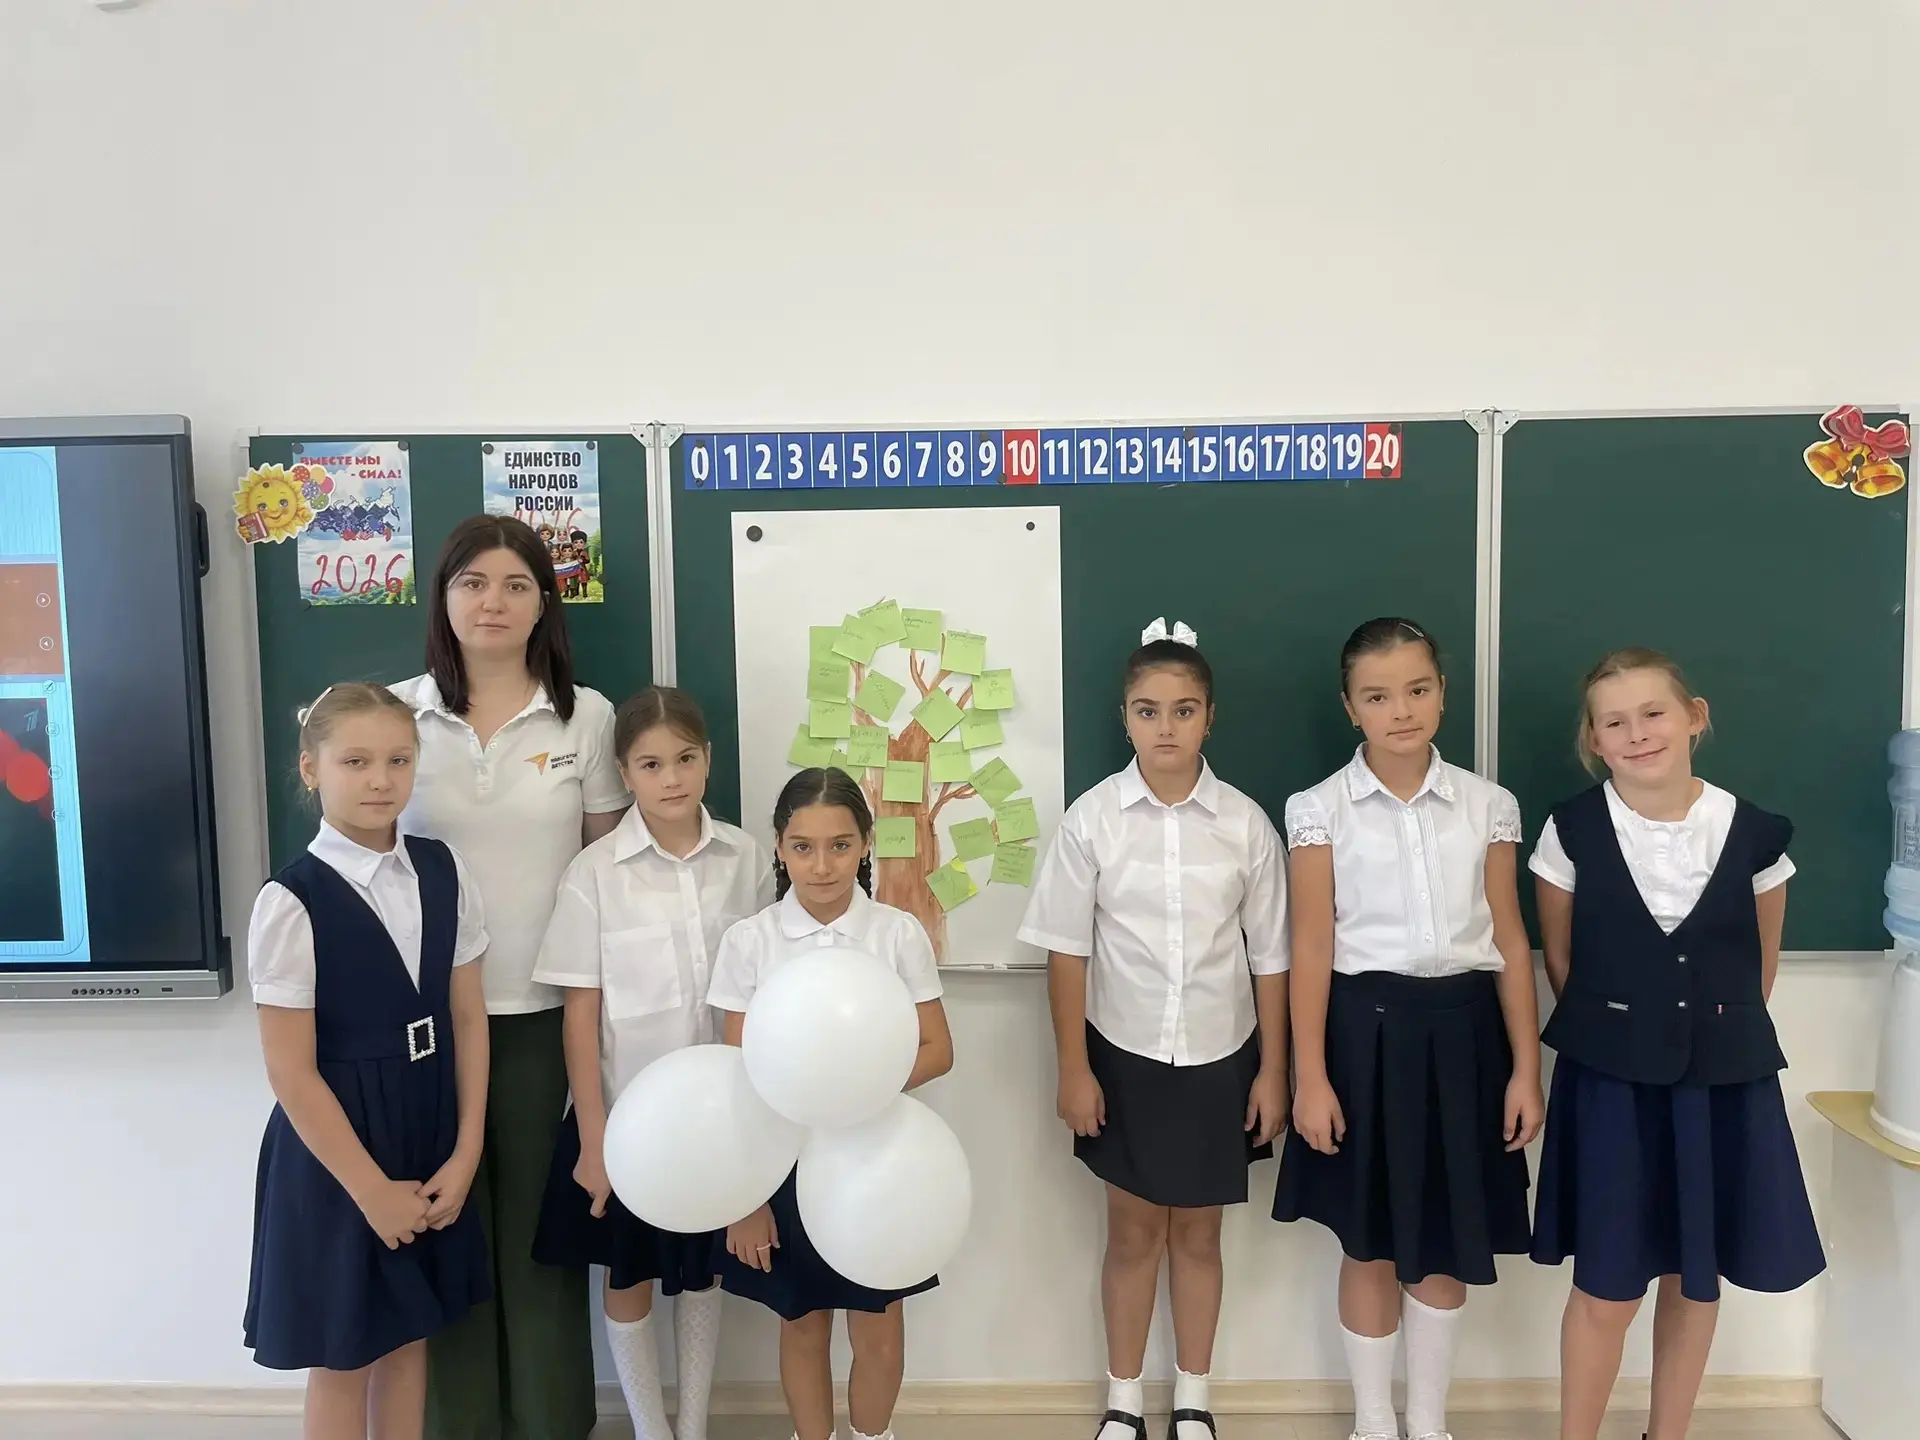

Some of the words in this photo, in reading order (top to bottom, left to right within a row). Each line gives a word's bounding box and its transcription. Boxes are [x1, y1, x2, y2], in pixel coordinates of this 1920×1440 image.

[300, 456, 352, 466] ВМЕСТЕ
[356, 456, 381, 465] МЫ
[504, 452, 581, 469] ЕДИНСТВО
[691, 445, 709, 481] 0
[724, 445, 737, 480] 1
[755, 444, 772, 479] 2
[788, 444, 803, 479] 3
[819, 443, 837, 478] 4
[852, 443, 868, 478] 5
[883, 442, 901, 478] 6
[916, 442, 932, 477] 7
[947, 441, 965, 477] 8
[978, 441, 997, 476] 9
[1008, 440, 1035, 475] 10
[1044, 440, 1069, 475] 11
[1080, 439, 1108, 474] 12
[1116, 438, 1144, 474] 13
[1152, 438, 1181, 473] 14
[1188, 437, 1217, 472] 15
[1225, 436, 1254, 471] 16
[1261, 435, 1290, 471] 17
[1297, 434, 1326, 470] 18
[1332, 433, 1362, 469] 19
[1366, 433, 1399, 470] 20
[359, 469, 402, 479] СИЛА!
[508, 474, 578, 491] НАРОДОВ
[515, 496, 574, 511] РОССИИ
[311, 553, 406, 595] 2026
